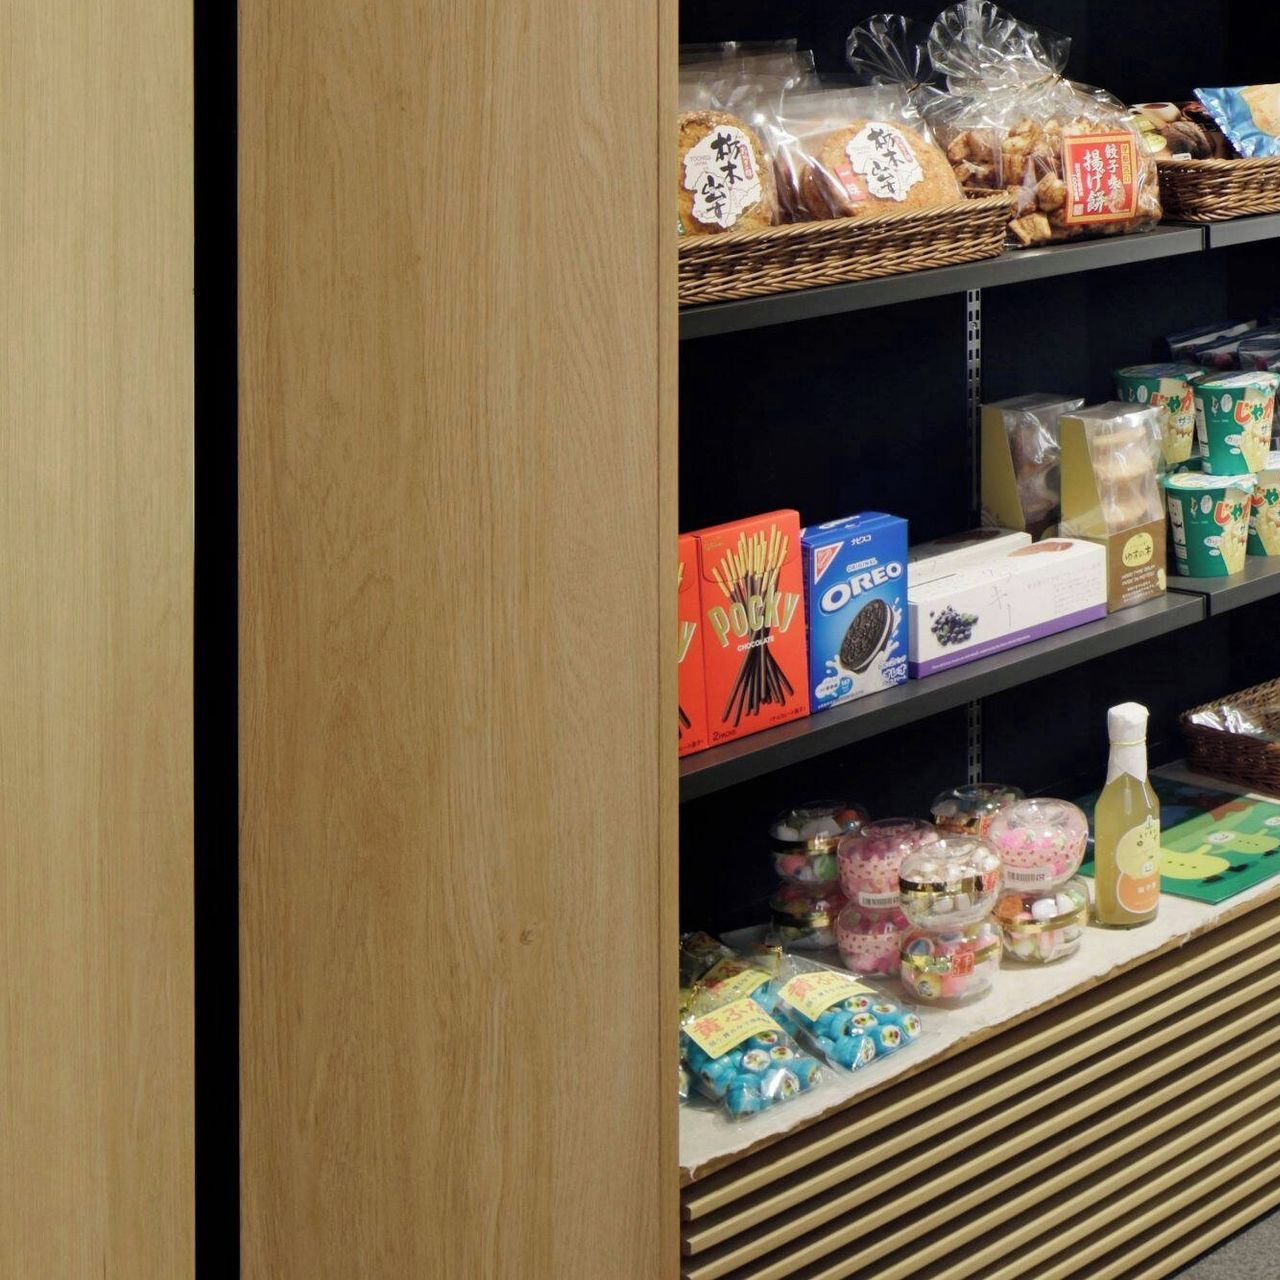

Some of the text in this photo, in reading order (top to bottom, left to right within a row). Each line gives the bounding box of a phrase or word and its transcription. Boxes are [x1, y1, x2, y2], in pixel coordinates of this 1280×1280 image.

[710, 131, 744, 185] 栃木
[866, 127, 905, 168] 栃木
[1082, 149, 1106, 213] 揚げ餅
[850, 534, 873, 546] ナビスコ
[819, 562, 904, 616] OREO
[736, 634, 776, 653] CHOCOLATE
